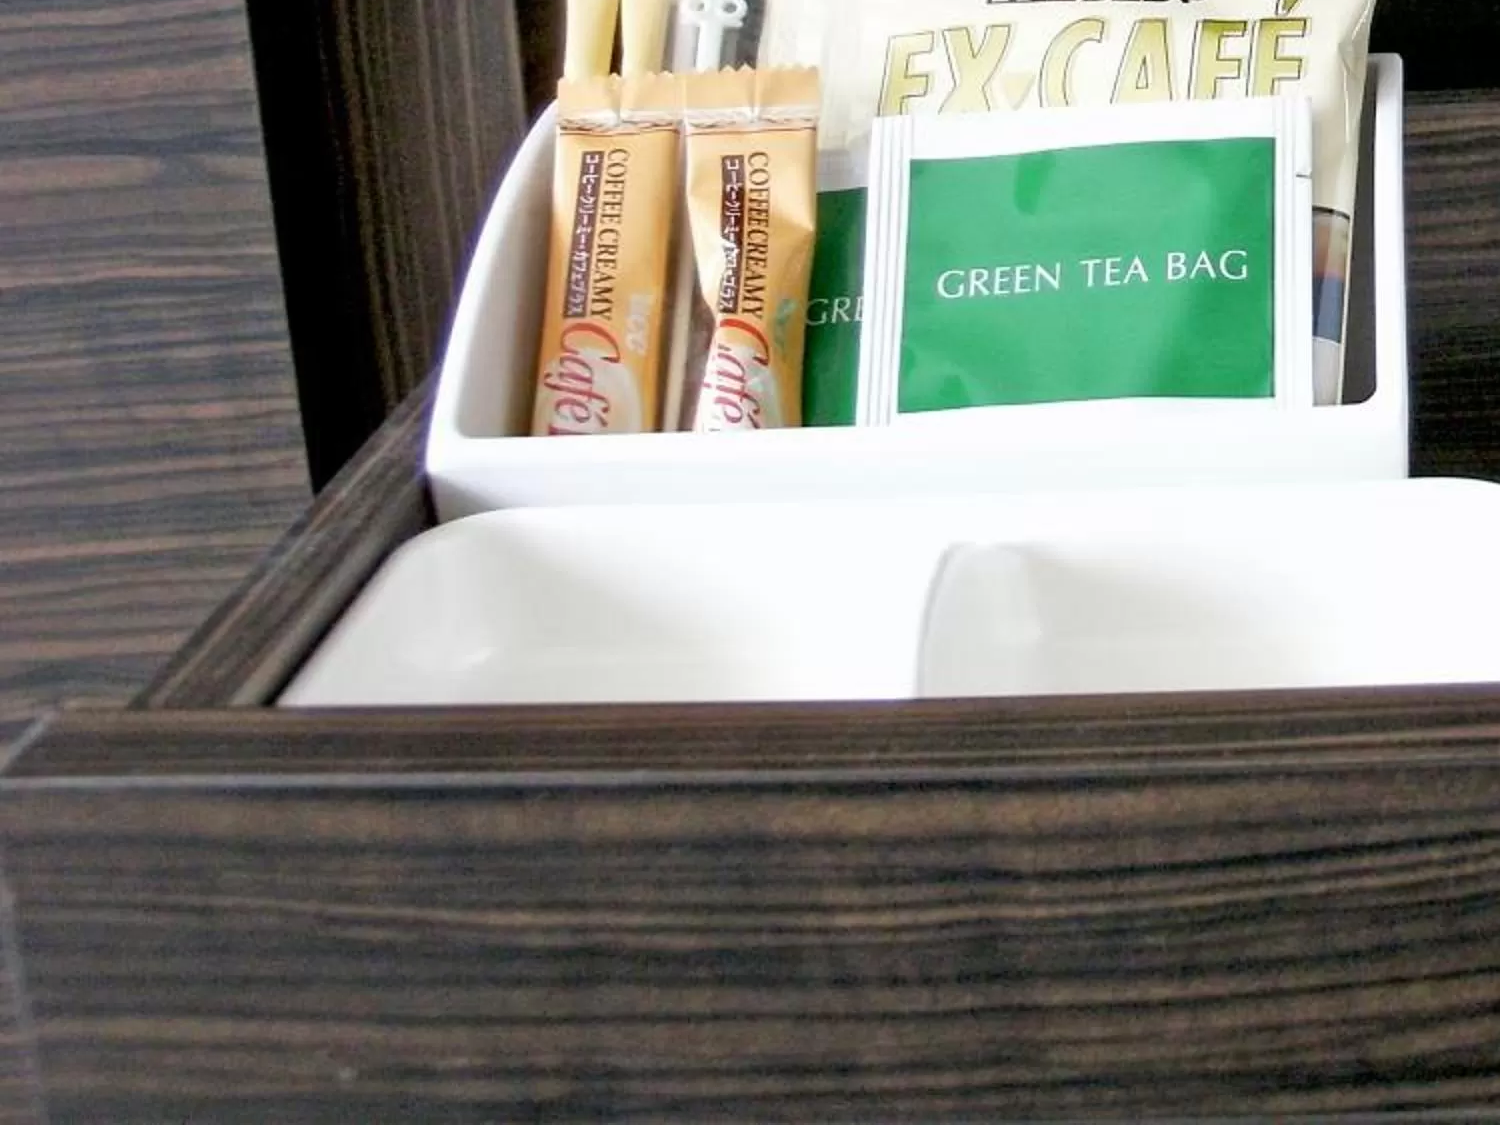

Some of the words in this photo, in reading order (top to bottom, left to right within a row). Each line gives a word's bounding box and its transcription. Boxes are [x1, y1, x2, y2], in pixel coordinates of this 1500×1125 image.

[877, 23, 1011, 116] EX
[601, 147, 631, 226] COFFEE
[747, 151, 769, 227] COFFEE
[590, 227, 621, 321] CREAMY
[742, 228, 769, 320] CREAMY
[937, 262, 1061, 299] GREEN
[1080, 254, 1149, 287] TEA
[1166, 250, 1249, 280] BAG
[544, 321, 621, 429] Café
